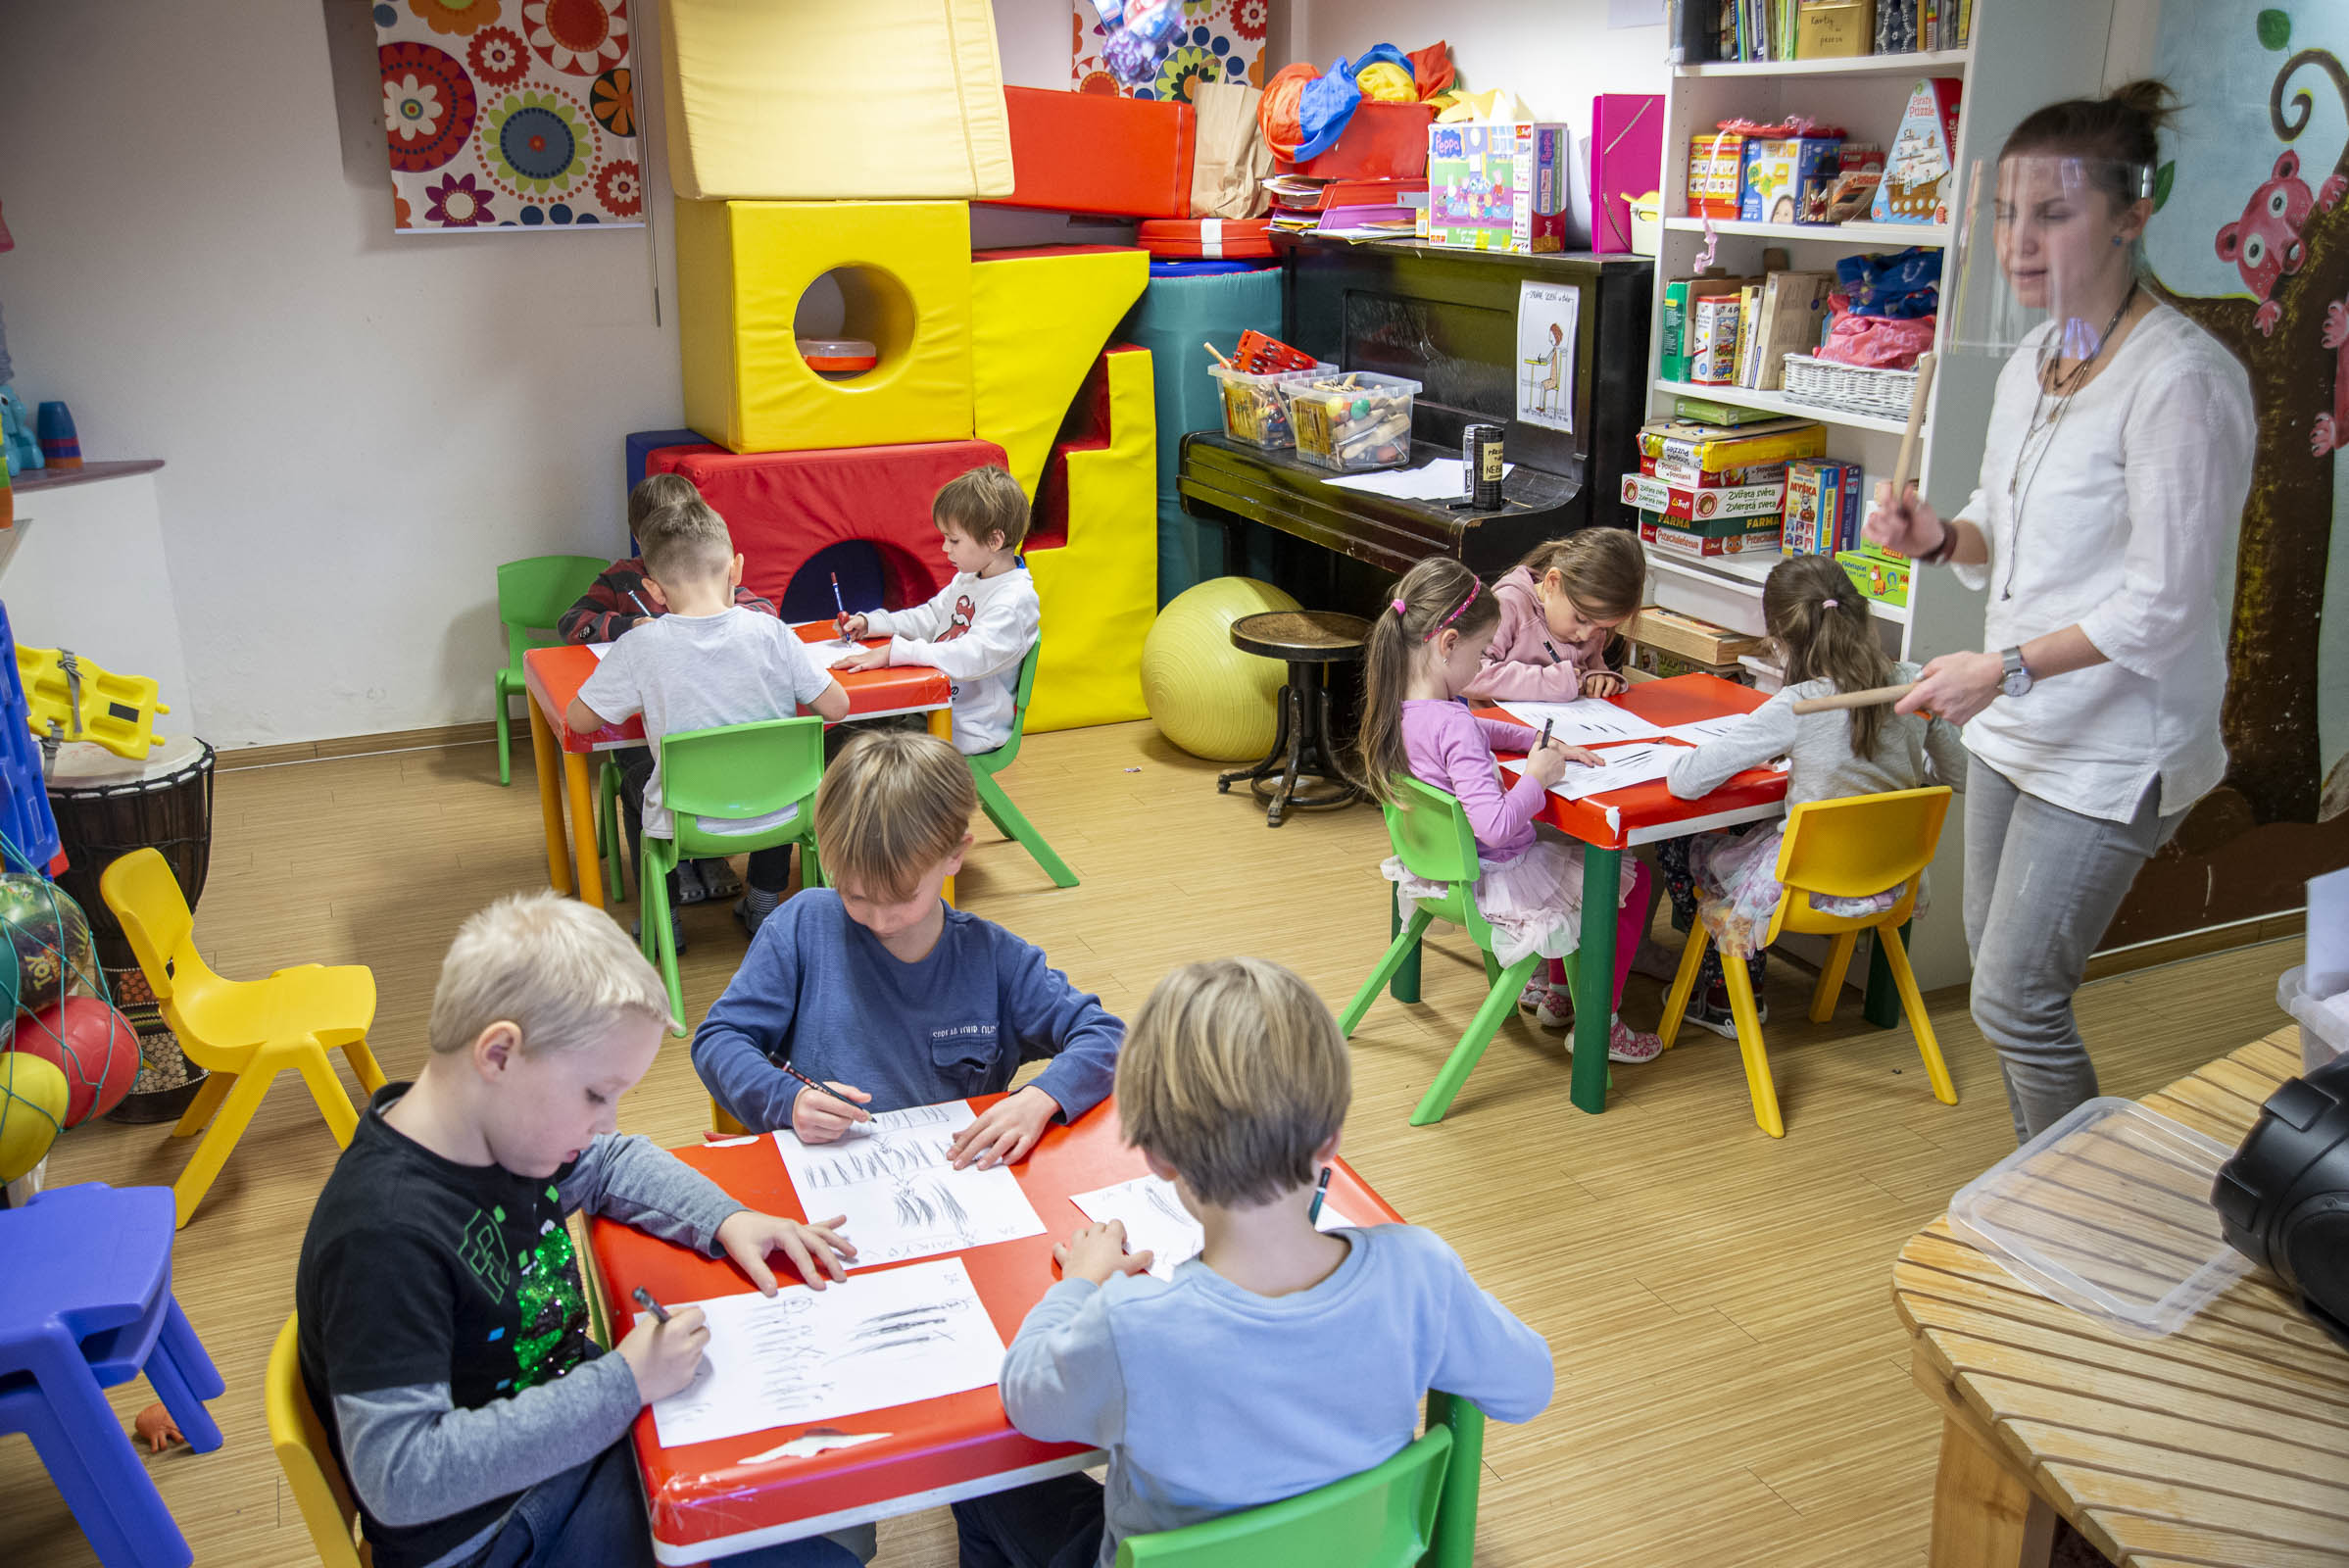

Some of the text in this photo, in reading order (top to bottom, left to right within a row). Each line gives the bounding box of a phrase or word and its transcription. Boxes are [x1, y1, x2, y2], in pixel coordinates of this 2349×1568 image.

[1912, 95, 1933, 106] Pirate
[1909, 105, 1935, 118] Puzzle
[1435, 132, 1460, 155] Peppa
[1542, 132, 1554, 163] Peppa
[1667, 446, 1689, 458] Puzzles
[1728, 487, 1776, 501] Zvířata světa
[1677, 498, 1689, 510] Trefl
[1726, 499, 1777, 513] Zvieratá sveta
[1658, 513, 1690, 529] FARMA
[1746, 515, 1780, 529] FARMA
[24, 956, 53, 991] TOY
